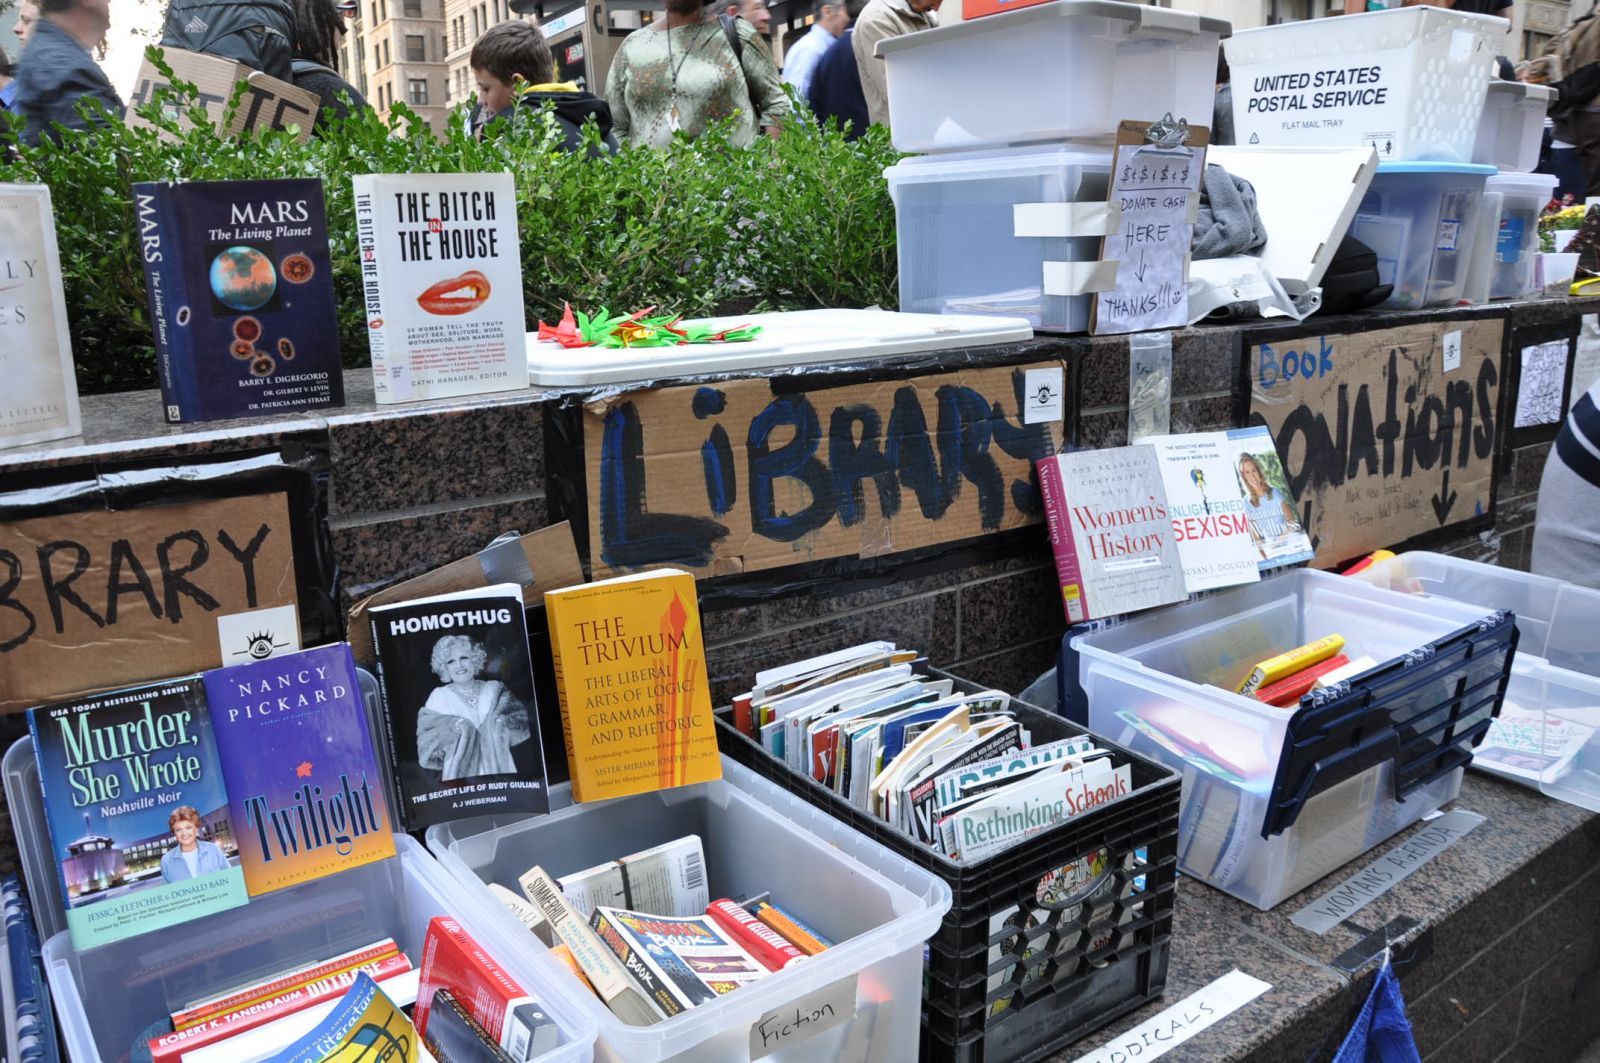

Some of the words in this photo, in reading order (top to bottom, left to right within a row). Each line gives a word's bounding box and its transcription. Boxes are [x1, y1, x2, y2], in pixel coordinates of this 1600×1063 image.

[1254, 73, 1310, 92] UNITED
[1313, 66, 1381, 87] STATES
[1248, 95, 1308, 113] POSTAL
[1312, 88, 1388, 109] SERVICE
[1282, 121, 1301, 130] FLAT
[1302, 120, 1320, 129] MAIL
[1322, 119, 1344, 128] TRAY
[230, 200, 309, 225] MARS
[357, 194, 372, 214] THE
[395, 192, 430, 223] THE
[439, 191, 496, 221] BITCH
[1121, 197, 1157, 213] DONATE
[1163, 196, 1186, 209] CASH
[137, 193, 163, 264] MARS
[209, 229, 231, 241] The
[234, 227, 273, 240] Living
[275, 225, 312, 238] Planet
[359, 218, 375, 252] BITCH
[429, 219, 442, 232] IN
[1125, 222, 1170, 253] HERE
[398, 230, 433, 262] THE
[440, 228, 498, 260] HOUSE
[365, 281, 381, 316] HOUSE
[418, 324, 444, 332] WOMEN
[1258, 335, 1333, 389] Book
[239, 377, 264, 387] BARRY
[275, 371, 328, 384] DIGREGORIO
[310, 384, 329, 392] LEVIN
[411, 378, 434, 387] CATHI
[480, 371, 508, 380] EDITOR
[261, 401, 290, 409] PATRICIA
[291, 398, 307, 406] ANN
[1073, 496, 1167, 532] Women's
[1168, 499, 1244, 519] ENLIGHTENED
[1171, 513, 1250, 542] SEXISM
[1087, 531, 1165, 561] History
[390, 609, 511, 636] HOMOTHUG
[574, 616, 627, 644] THE
[577, 631, 689, 666] TRIVIUM
[238, 666, 328, 698] NANCY
[554, 654, 563, 681] THE
[584, 674, 613, 691] THE
[618, 665, 674, 686] LIBERAL
[50, 708, 68, 718] USA
[72, 702, 101, 713] TODAY
[104, 690, 159, 707] BESTSELLING
[162, 685, 190, 696] SERIES
[228, 684, 346, 723] PICKARD
[586, 693, 619, 710] ARTS
[623, 688, 642, 702] OF
[55, 701, 198, 769] Murder,
[558, 686, 575, 758] TRIVIUM
[591, 728, 624, 746] AND
[628, 714, 703, 740] RHETORIC
[68, 766, 121, 808] She
[122, 752, 201, 793] Wrote
[595, 764, 622, 777] SISTER
[623, 759, 656, 771] MIRIAM
[101, 795, 155, 818] Nashville
[157, 790, 182, 805] Noir
[412, 793, 427, 804] THE
[428, 788, 458, 800] SECRET
[459, 786, 475, 794] LIFE
[489, 782, 508, 790] RUDY
[509, 781, 540, 789] GIULIANI
[465, 796, 507, 806] WEBERMAN
[244, 770, 382, 863] Twilight
[964, 797, 1065, 847] Rethinking
[1065, 772, 1127, 818] Schools
[1387, 826, 1461, 869] AGENDA
[87, 907, 121, 923] JESSICA
[121, 894, 165, 914] FLETCHER
[171, 883, 208, 900] DONALD
[209, 877, 230, 890] BAIN
[527, 876, 569, 927] SUMMERHILL
[441, 920, 459, 934] life
[645, 931, 719, 948] BOOK
[626, 953, 655, 990] BOOK
[159, 1024, 208, 1048] ROBERT
[210, 1018, 224, 1029] K.
[224, 990, 302, 1024] TANENBAUM
[317, 985, 376, 1057] Literature
[758, 1003, 835, 1048] Fiction
